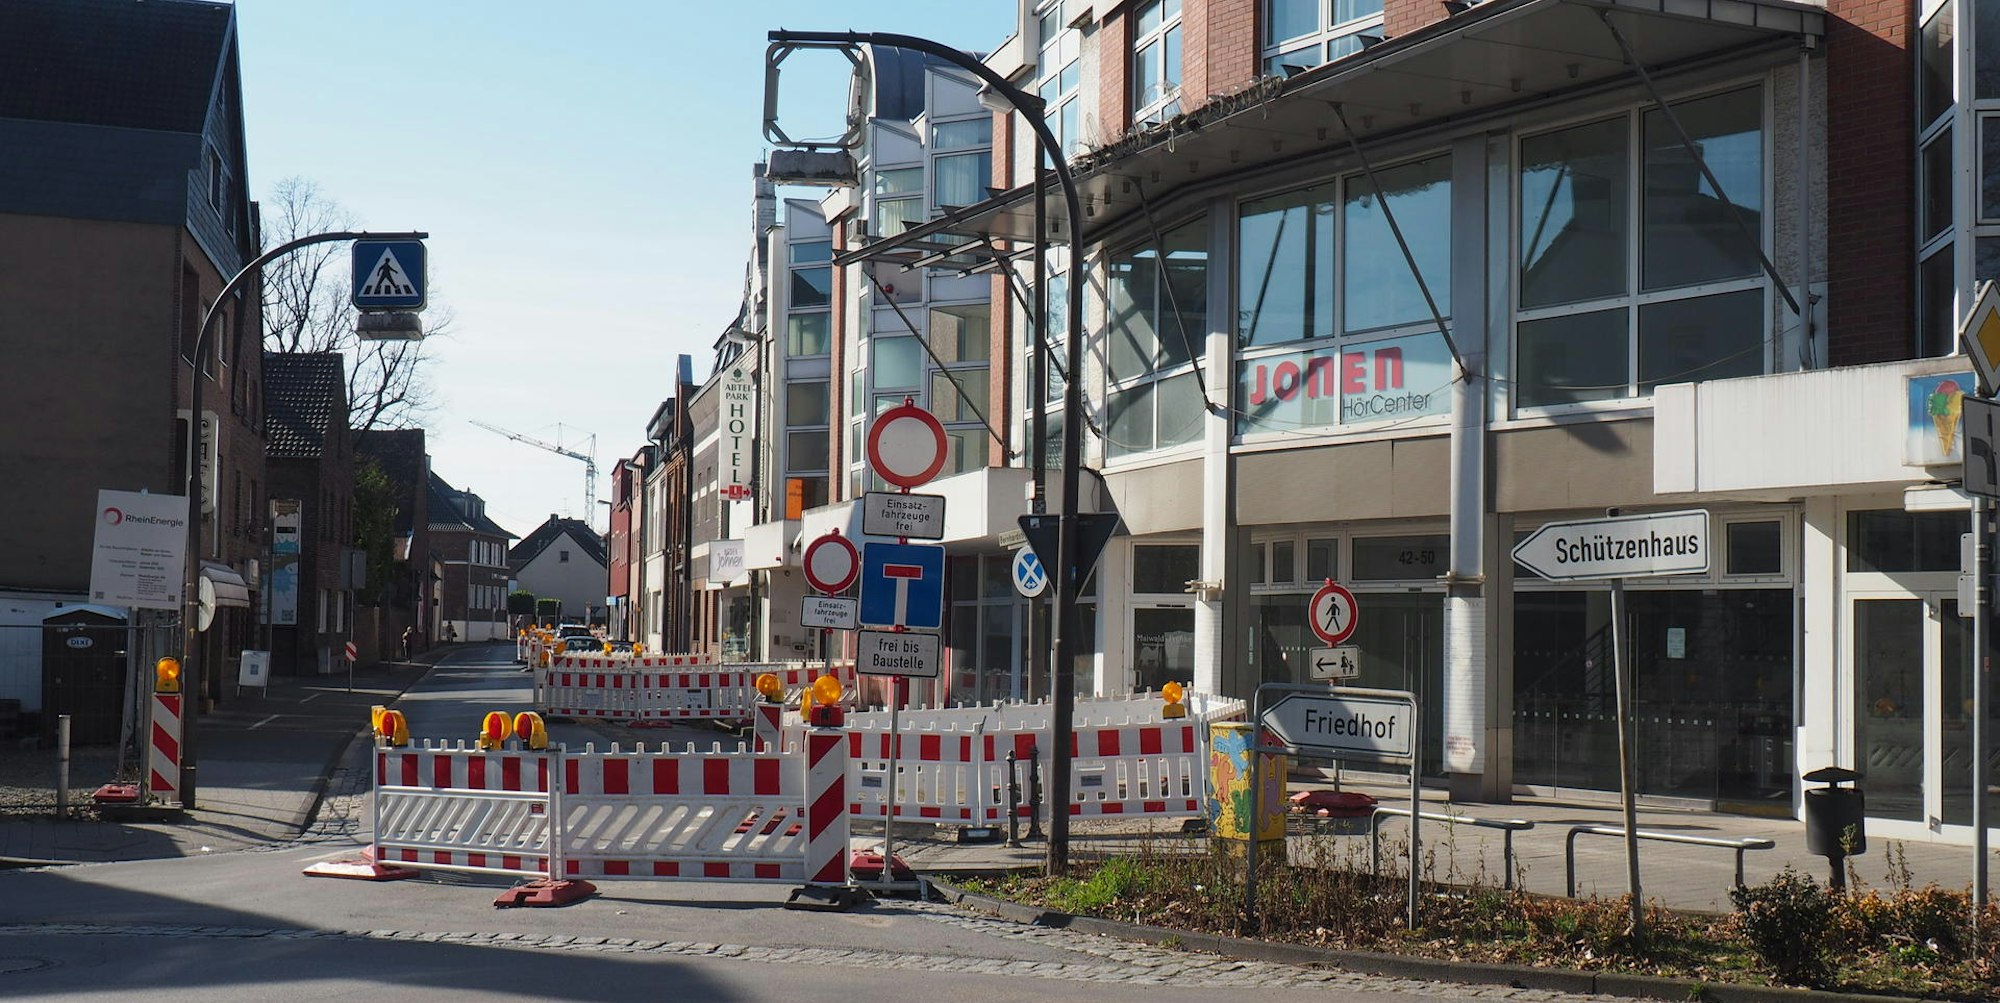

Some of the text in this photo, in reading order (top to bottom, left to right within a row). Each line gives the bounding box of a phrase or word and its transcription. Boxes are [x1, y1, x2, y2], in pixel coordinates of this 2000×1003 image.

[725, 384, 751, 392] ABTEI
[1343, 391, 1431, 417] HörCenter
[728, 404, 745, 484] HOTEL
[887, 499, 927, 511] Einsatz-
[125, 514, 184, 528] RheinEnergie
[881, 510, 930, 522] fahrzeuge
[896, 521, 913, 531] frei
[1556, 531, 1699, 564] Schützenhaus
[1399, 551, 1435, 565] 42-50
[818, 600, 847, 609] Einsatz-
[814, 608, 848, 618] fahrzeuge
[823, 616, 836, 624] frei
[879, 638, 919, 653] frei bis
[872, 654, 924, 669] Baustelle
[1305, 708, 1395, 739] Friedhof
